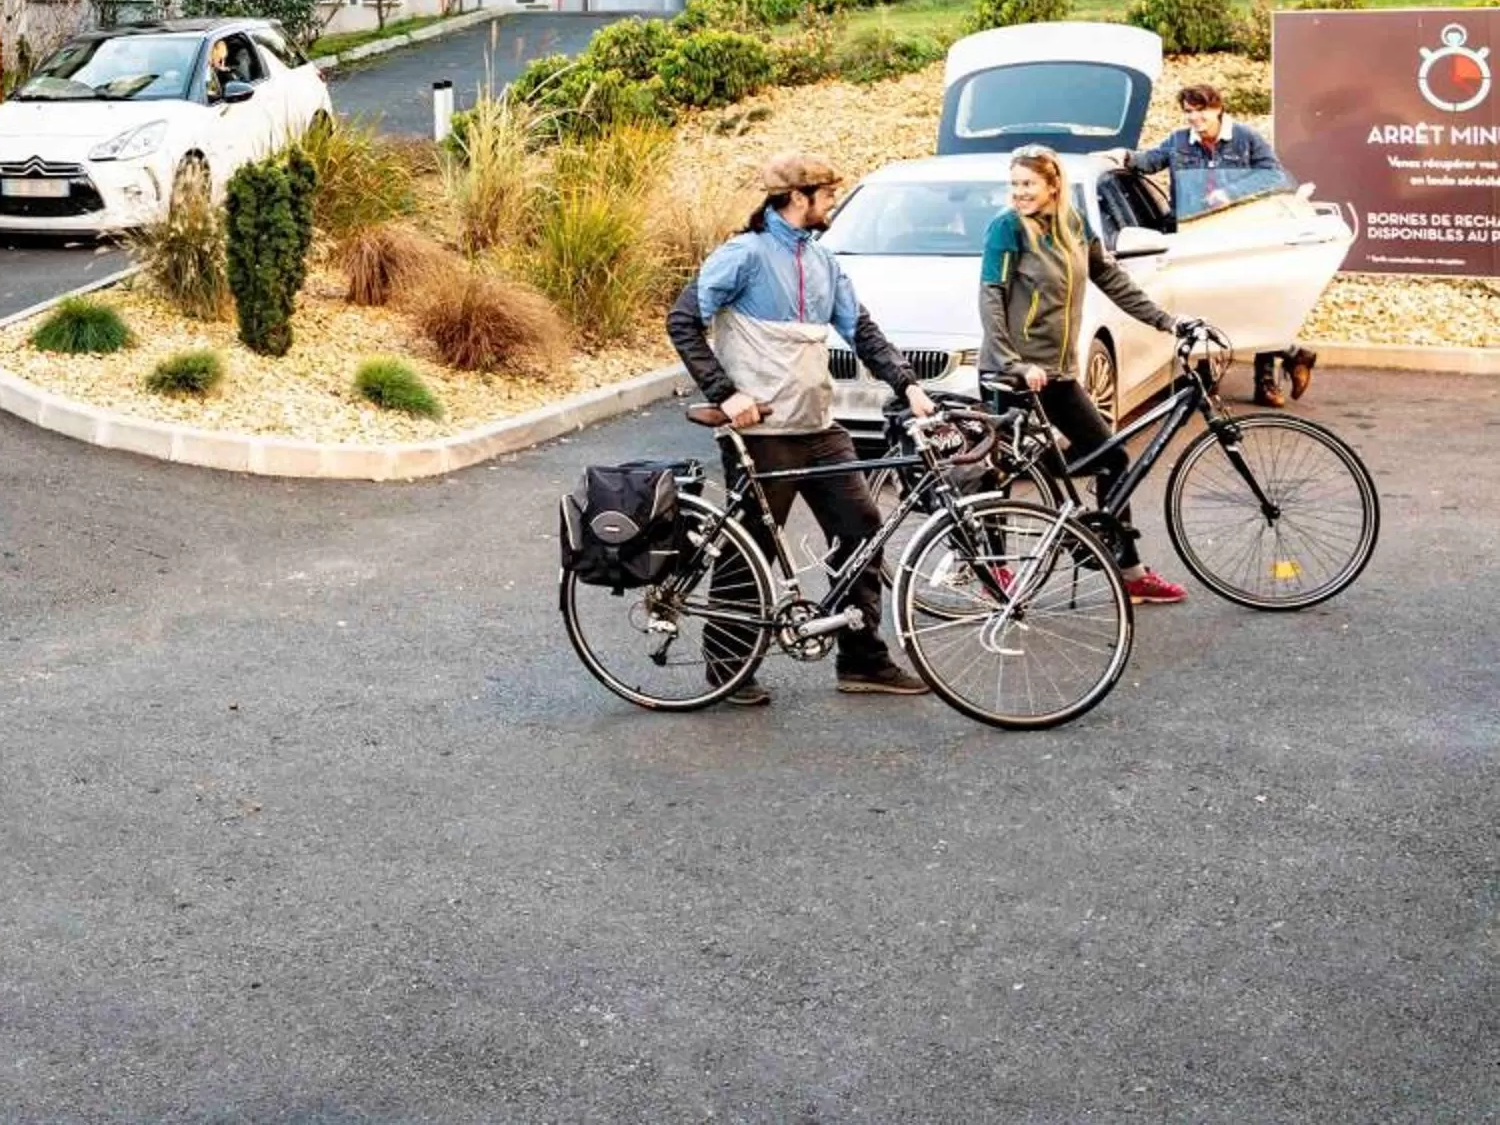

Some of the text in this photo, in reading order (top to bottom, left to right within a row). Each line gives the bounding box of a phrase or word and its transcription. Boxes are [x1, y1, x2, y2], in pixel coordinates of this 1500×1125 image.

[1367, 121, 1500, 145] ARRÊT MIN
[1367, 213, 1427, 226] BORNES
[1431, 214, 1451, 227] DE
[1367, 226, 1464, 242] DISPONIBLES
[1467, 230, 1489, 242] AU
